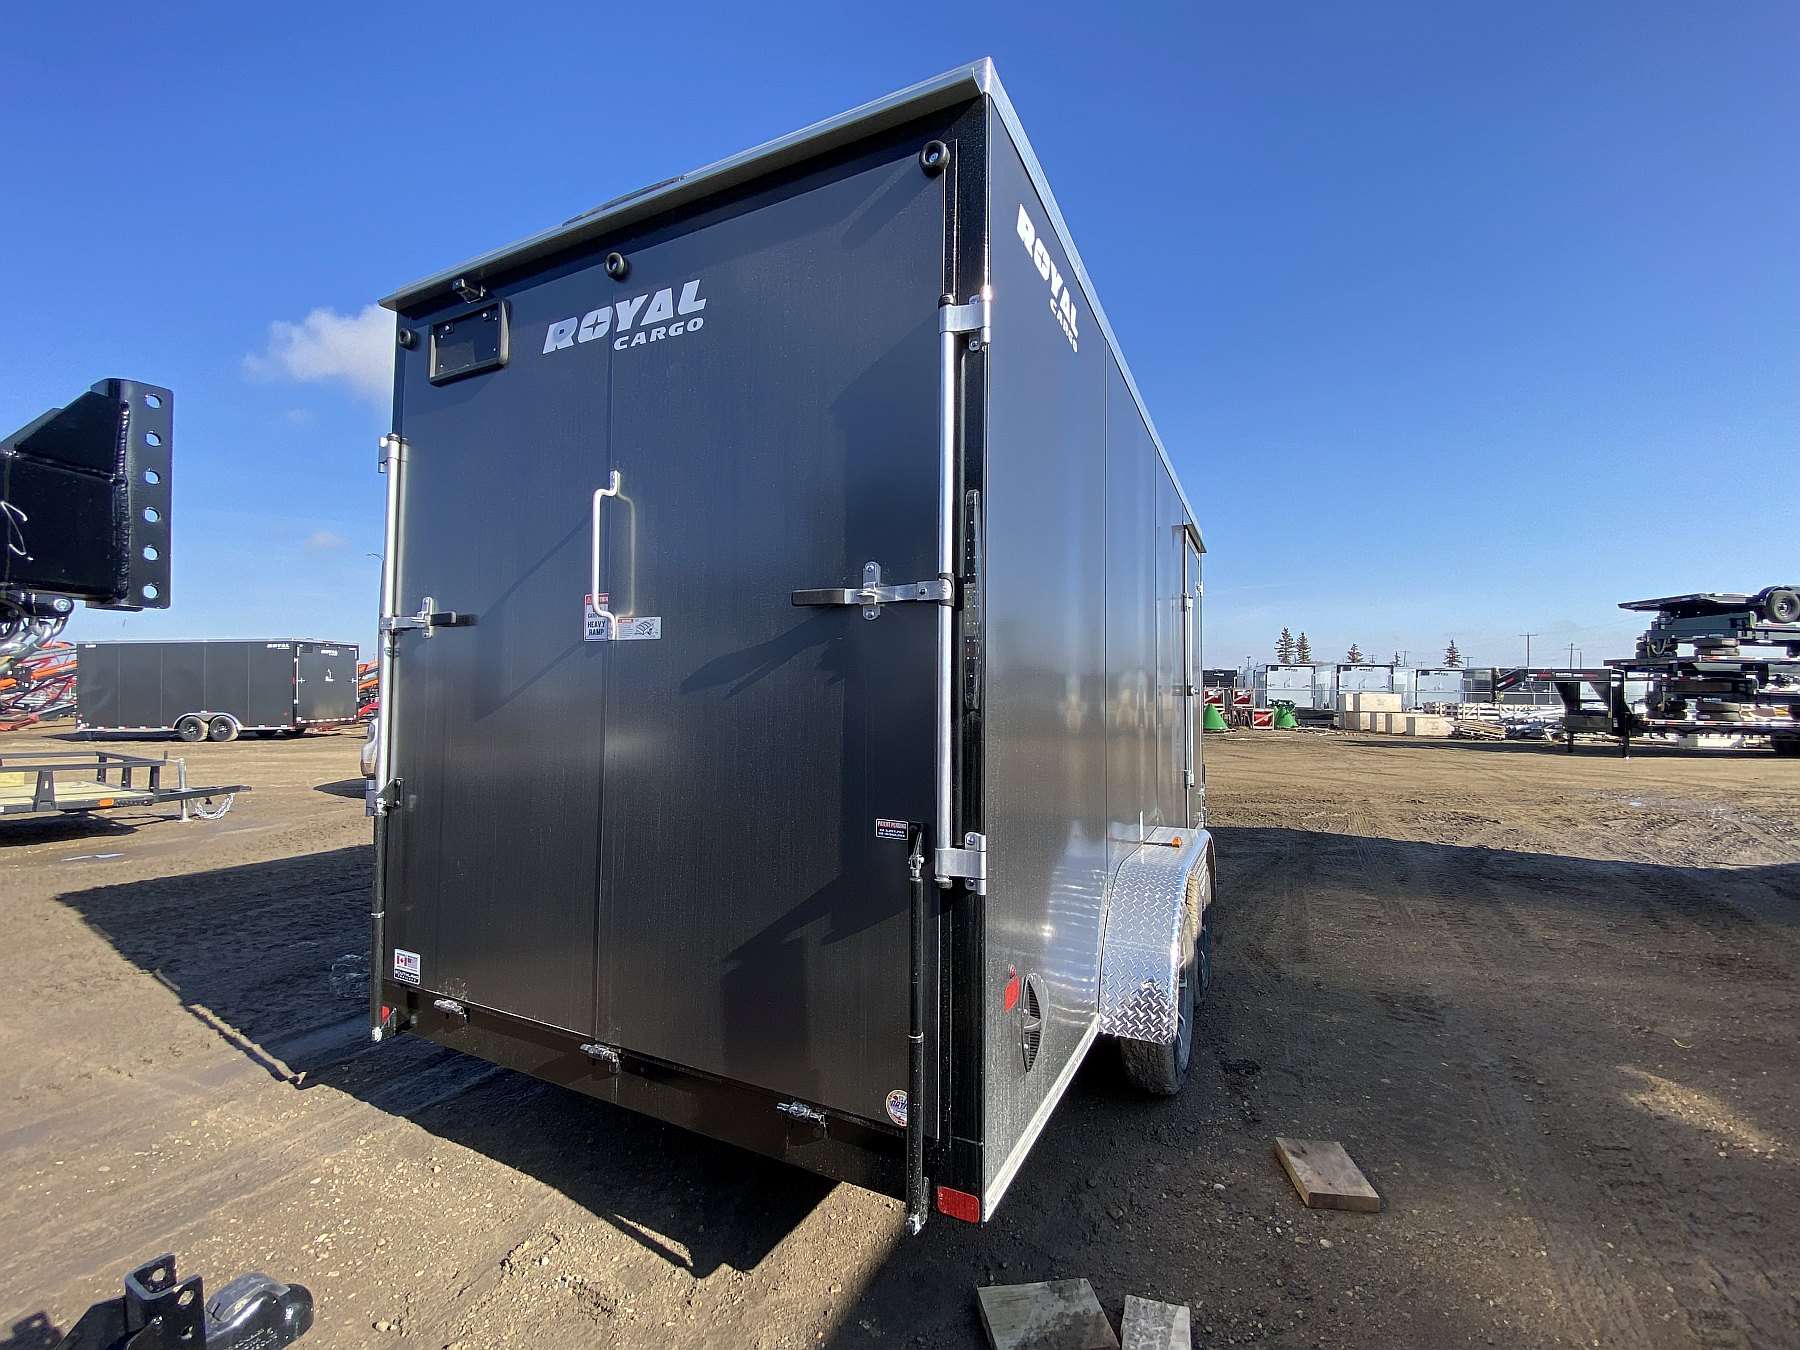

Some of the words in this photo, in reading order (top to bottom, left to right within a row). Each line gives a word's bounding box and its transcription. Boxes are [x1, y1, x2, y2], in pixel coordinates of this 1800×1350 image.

[1016, 203, 1079, 339] ROYAL
[543, 280, 707, 354] ROYAL
[613, 317, 704, 351] CARGO
[1049, 298, 1078, 353] CARGO
